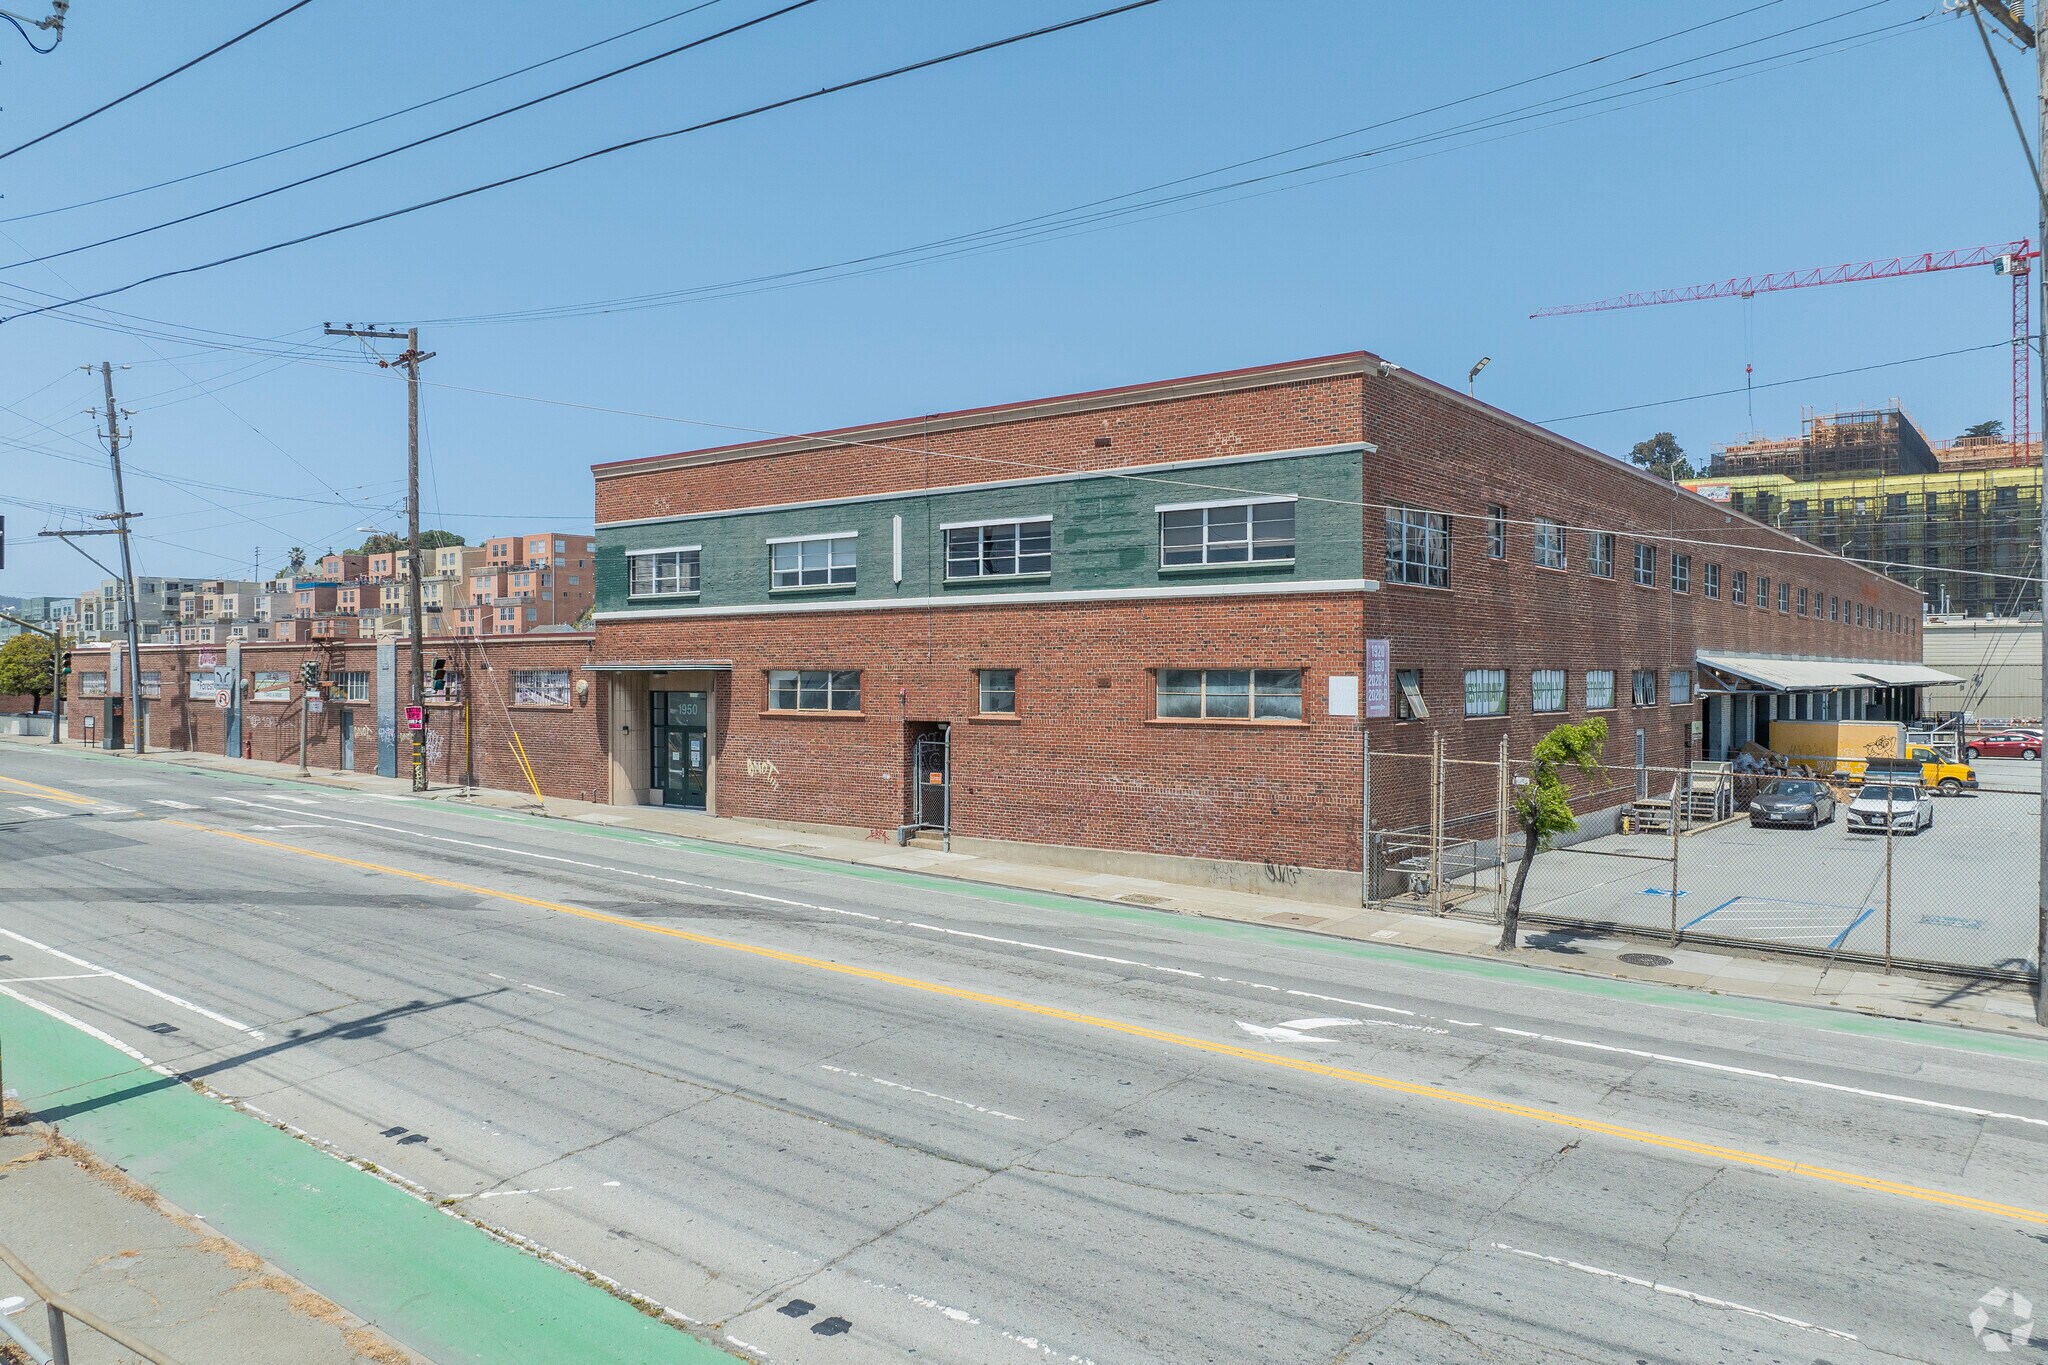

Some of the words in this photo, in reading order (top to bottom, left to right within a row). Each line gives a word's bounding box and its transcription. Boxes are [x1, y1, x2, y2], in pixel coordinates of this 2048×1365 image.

[1371, 645, 1385, 658] 1920
[1371, 660, 1385, 672] 1950
[1368, 674, 1388, 687] 2020-A
[1368, 688, 1388, 701] 2020-B
[679, 703, 698, 715] 1950
